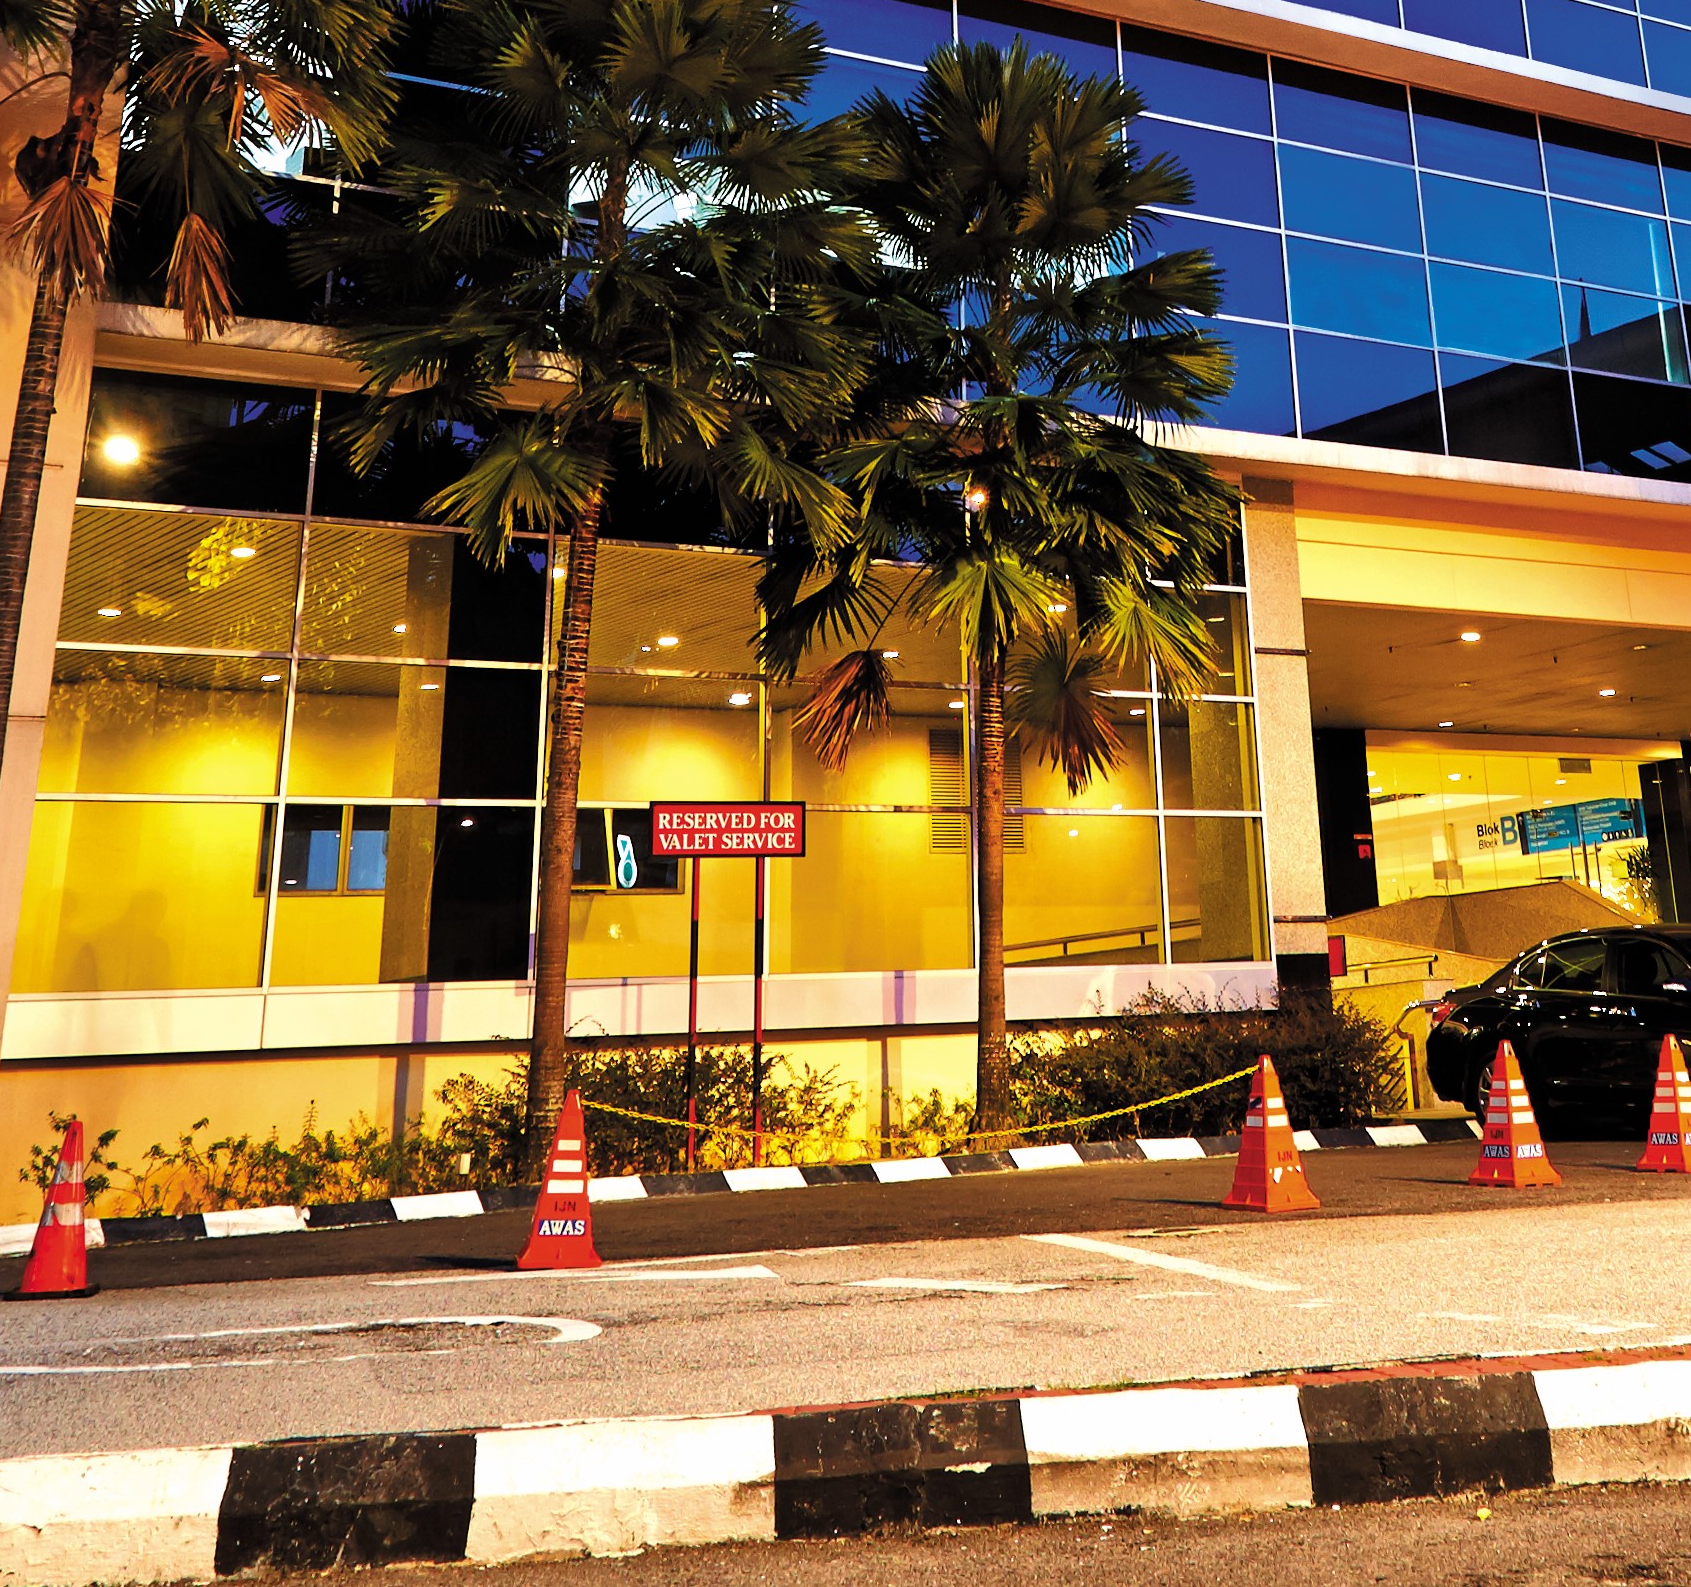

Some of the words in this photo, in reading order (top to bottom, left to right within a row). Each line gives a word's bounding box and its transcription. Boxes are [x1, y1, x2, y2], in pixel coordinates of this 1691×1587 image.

[658, 812, 756, 829] RESERVED
[760, 812, 796, 829] FOR
[1476, 822, 1500, 838] Blok
[1500, 815, 1519, 845] B
[659, 833, 718, 850] VALET
[721, 832, 796, 849] SERVICE
[1651, 1133, 1679, 1145] AWAS
[1483, 1145, 1510, 1158] AWAS
[554, 1200, 577, 1212] IJN
[538, 1219, 586, 1236] AWAS
